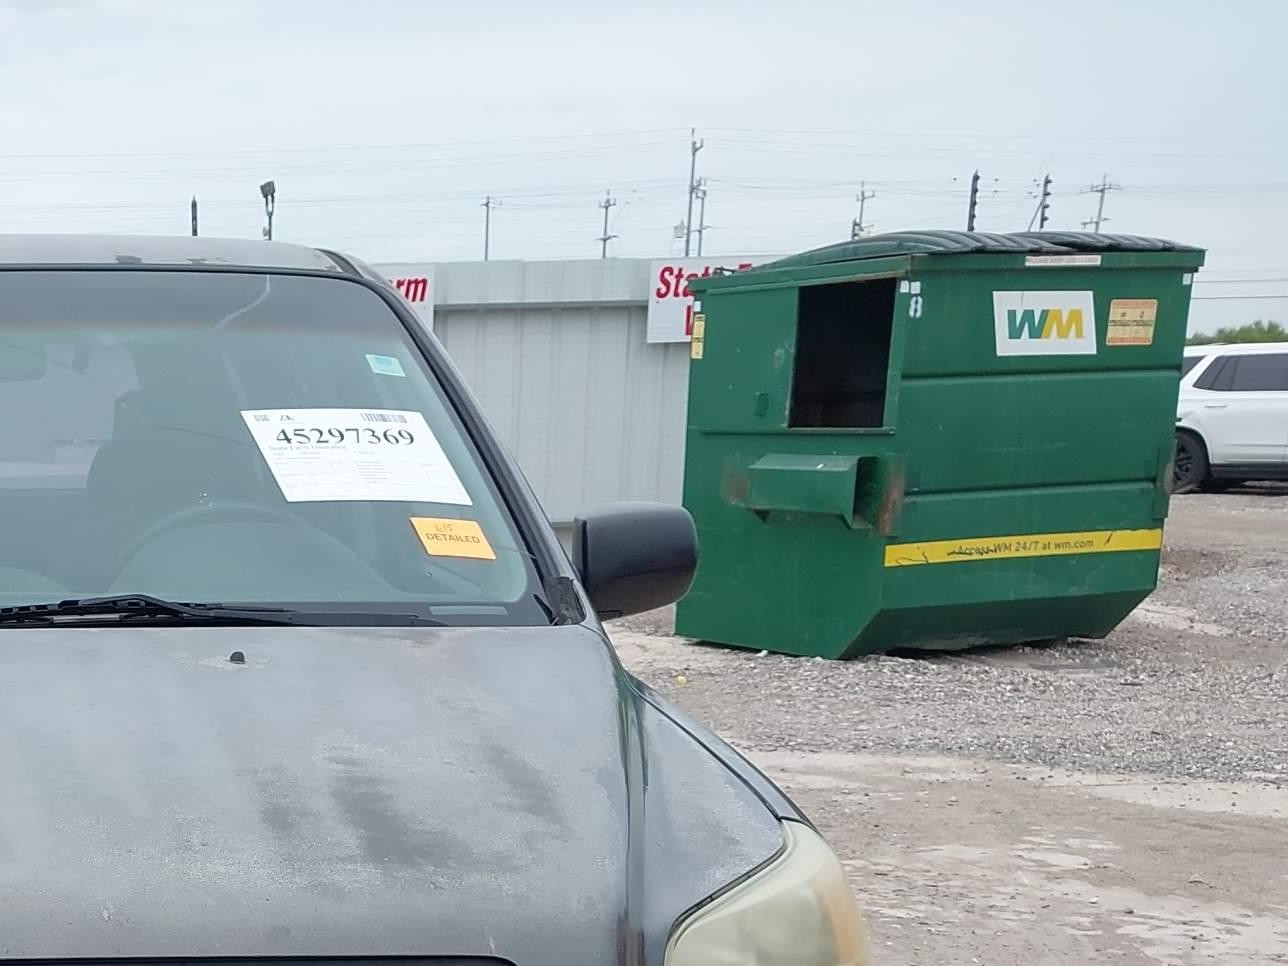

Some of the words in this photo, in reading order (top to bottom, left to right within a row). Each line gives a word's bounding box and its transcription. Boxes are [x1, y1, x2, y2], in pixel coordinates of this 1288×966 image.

[1007, 309, 1084, 340] WM
[276, 427, 415, 446] 45297369
[425, 532, 480, 544] DETAILED
[993, 543, 1012, 552] WM
[1014, 541, 1039, 552] 24/7
[1041, 540, 1052, 550] at
[1054, 539, 1094, 550] wm.com
